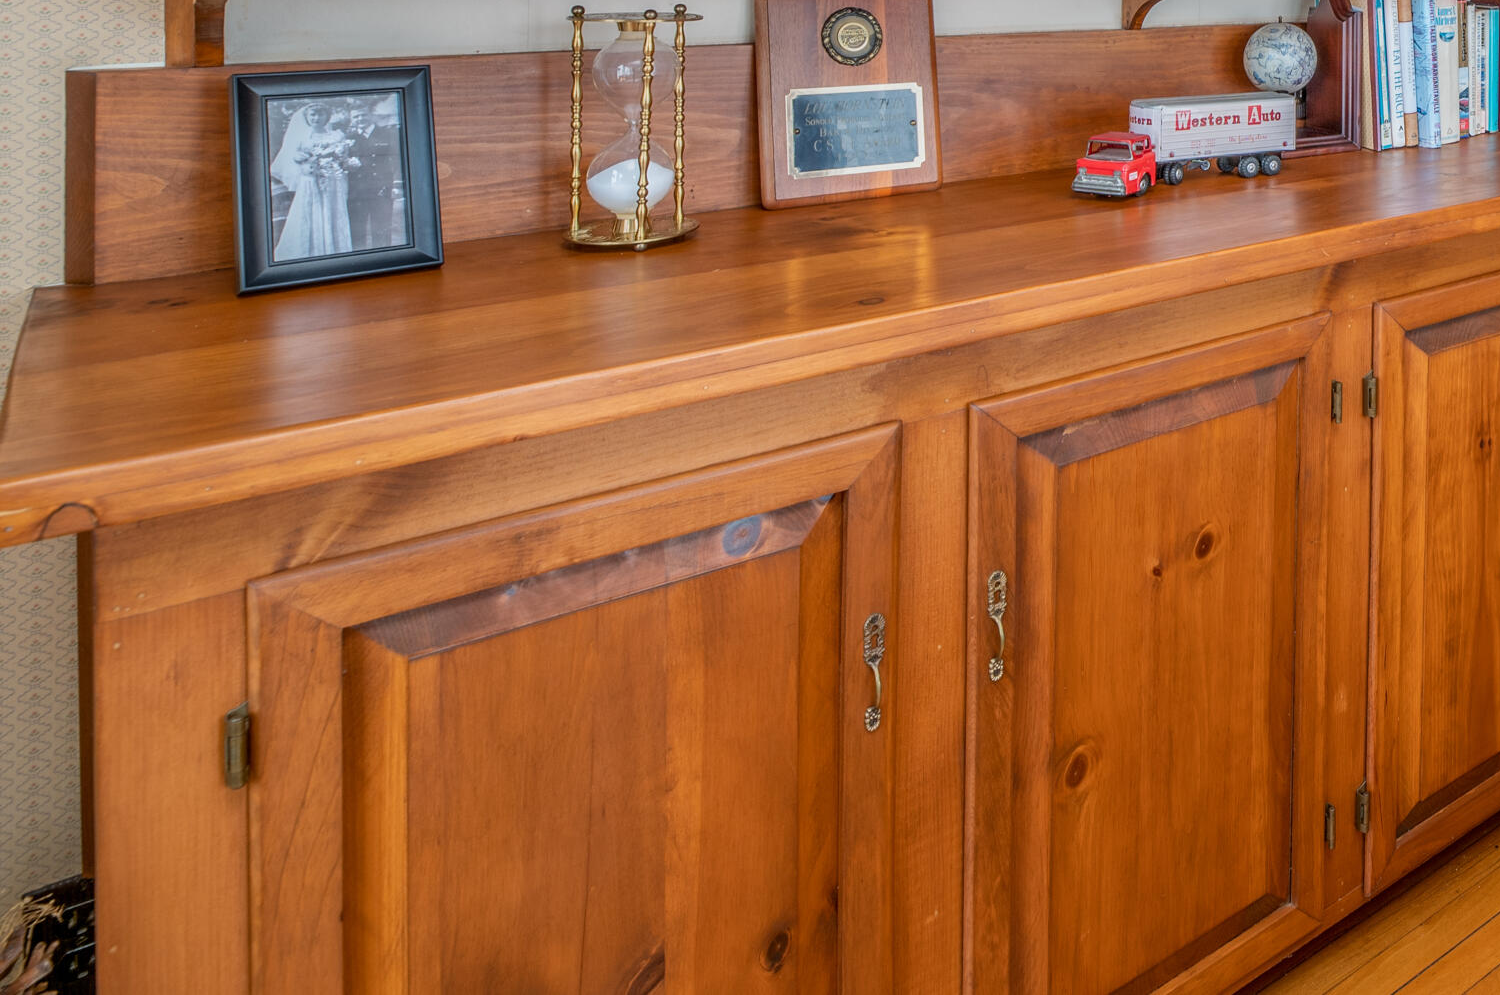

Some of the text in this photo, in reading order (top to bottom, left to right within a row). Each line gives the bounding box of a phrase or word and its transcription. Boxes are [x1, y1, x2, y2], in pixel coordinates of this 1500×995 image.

[1393, 49, 1404, 119] EAT THE RICH
[1432, 63, 1440, 114] MARGARITAVILLE
[1176, 105, 1281, 131] Western Auto
